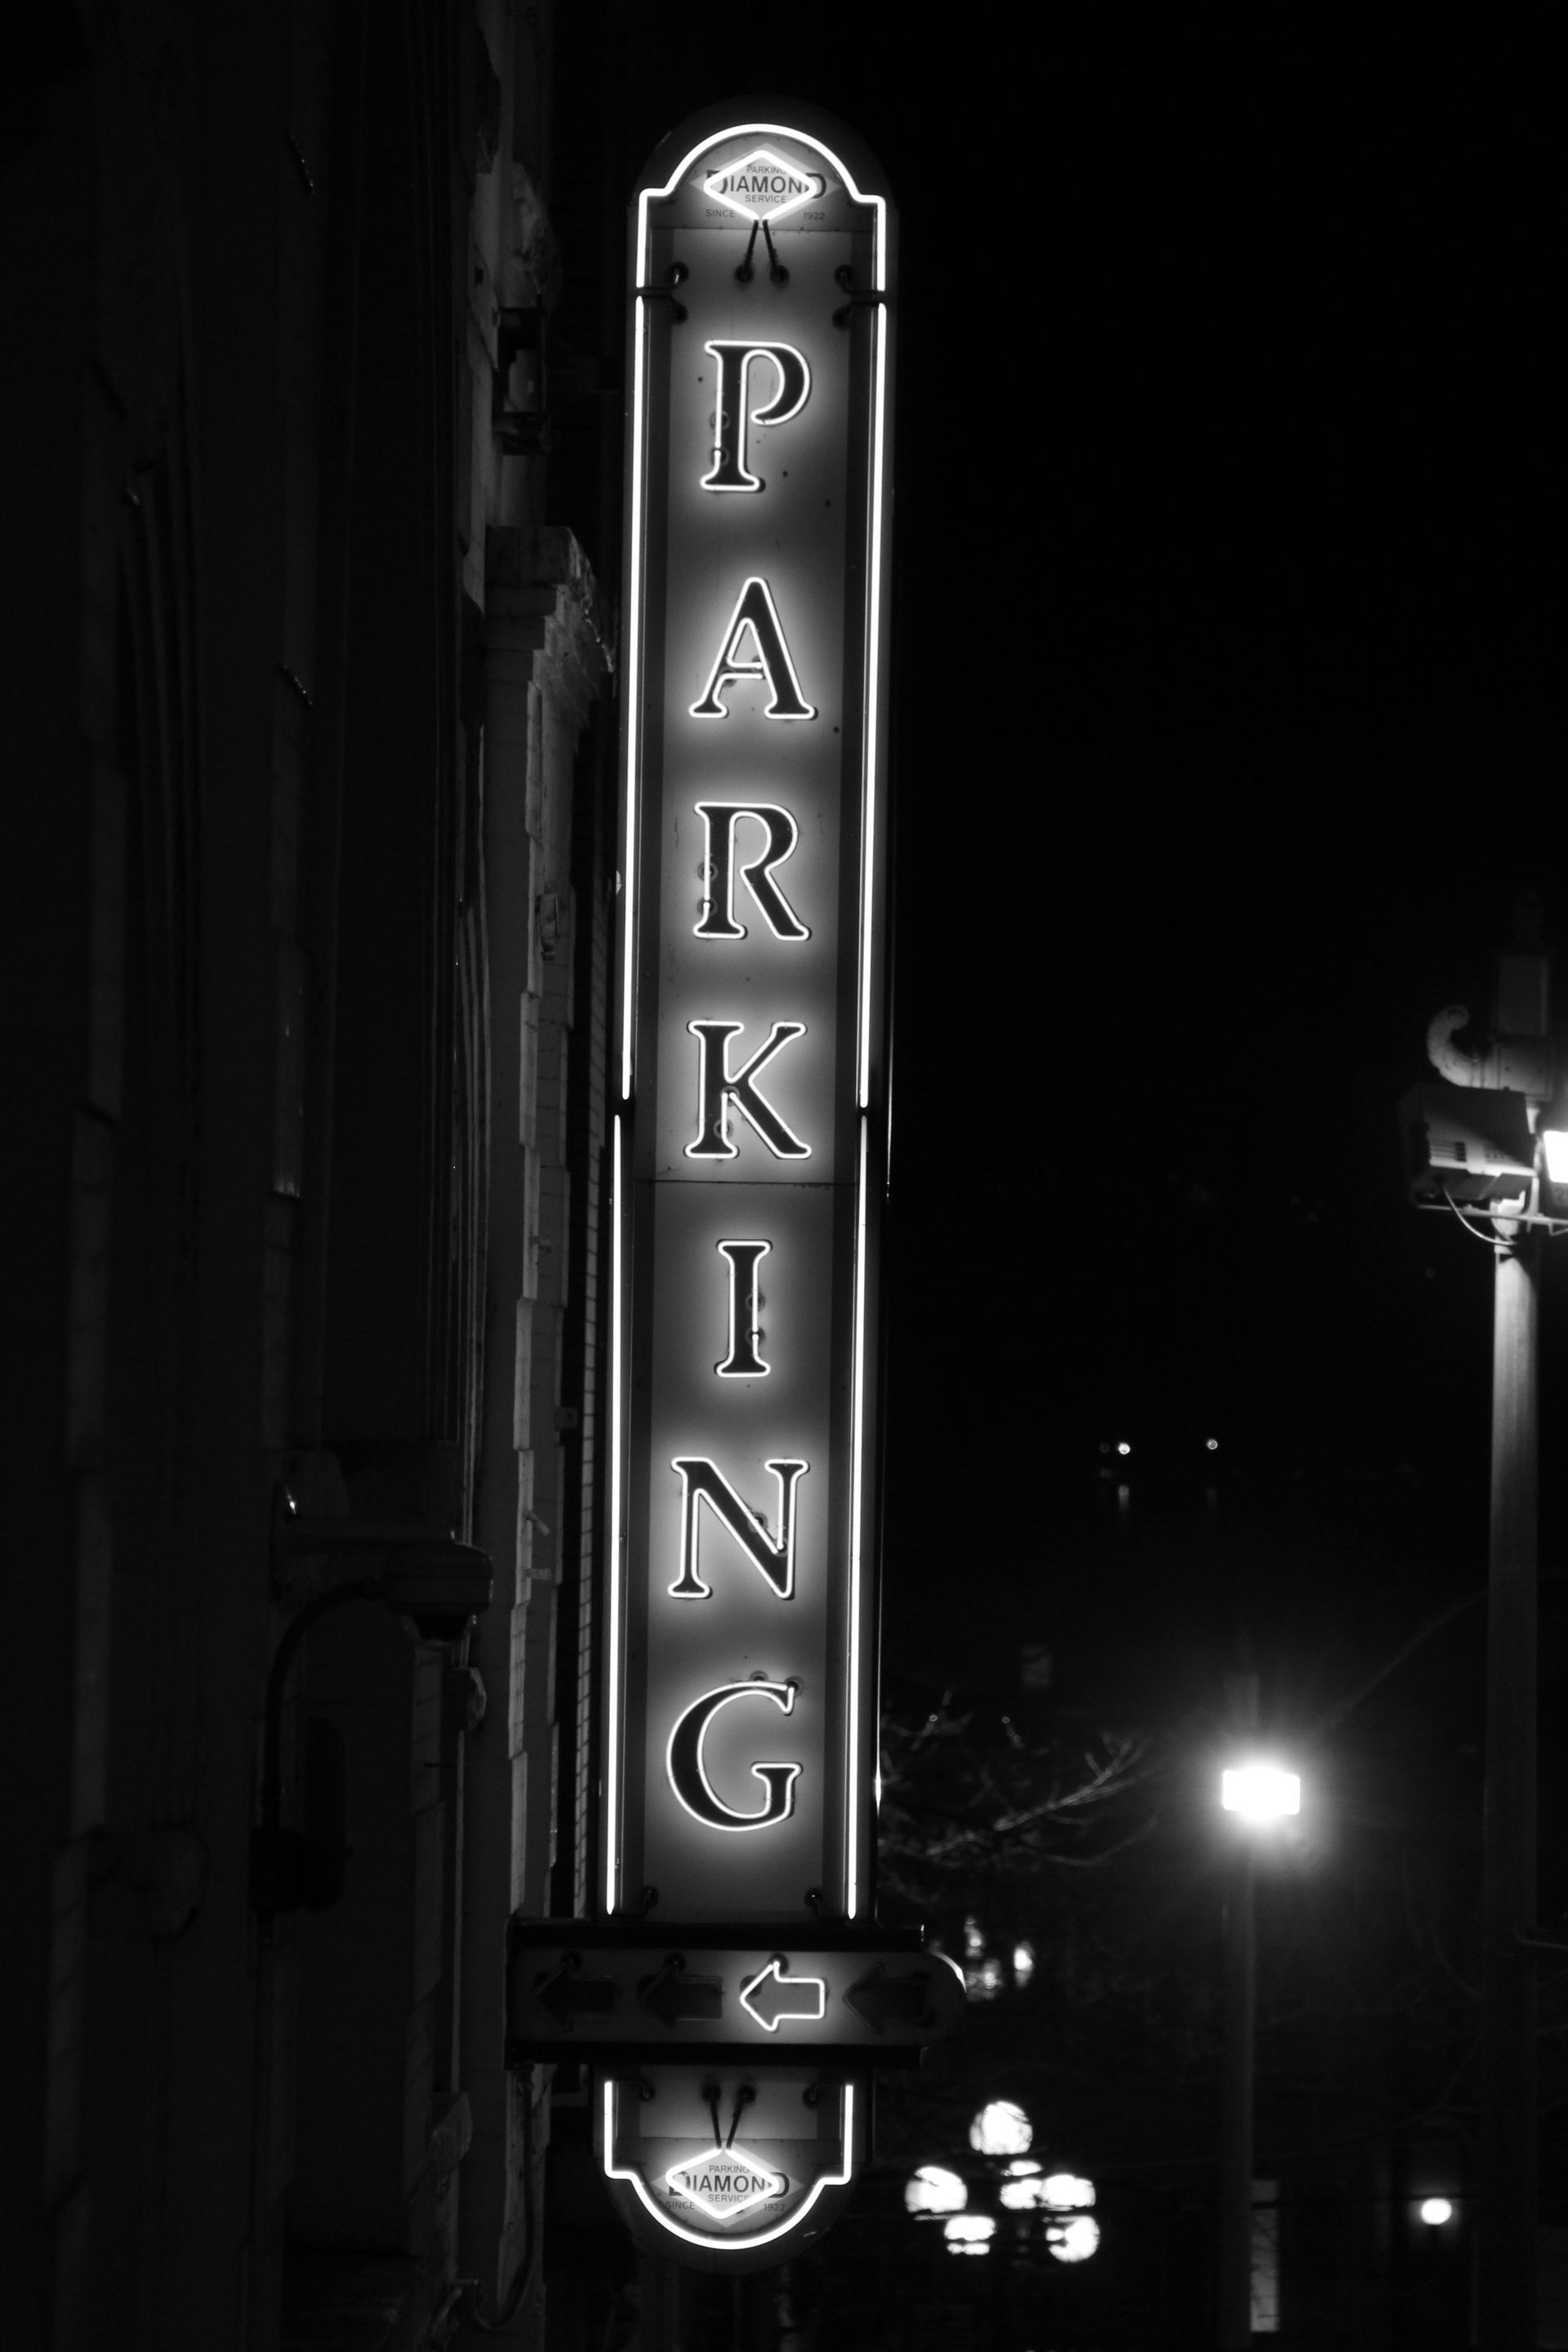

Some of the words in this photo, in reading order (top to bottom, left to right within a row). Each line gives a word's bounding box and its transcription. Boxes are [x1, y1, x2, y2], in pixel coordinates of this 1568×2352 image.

[745, 194, 787, 203] SERVICE
[705, 208, 736, 218] SINCE
[804, 212, 825, 220] 1922
[665, 340, 817, 1832] PARKING
[709, 2164, 750, 2174] PARKING
[708, 2194, 750, 2203] SERVICE
[666, 2201, 695, 2210] SINCE
[764, 2203, 786, 2212] 1922
